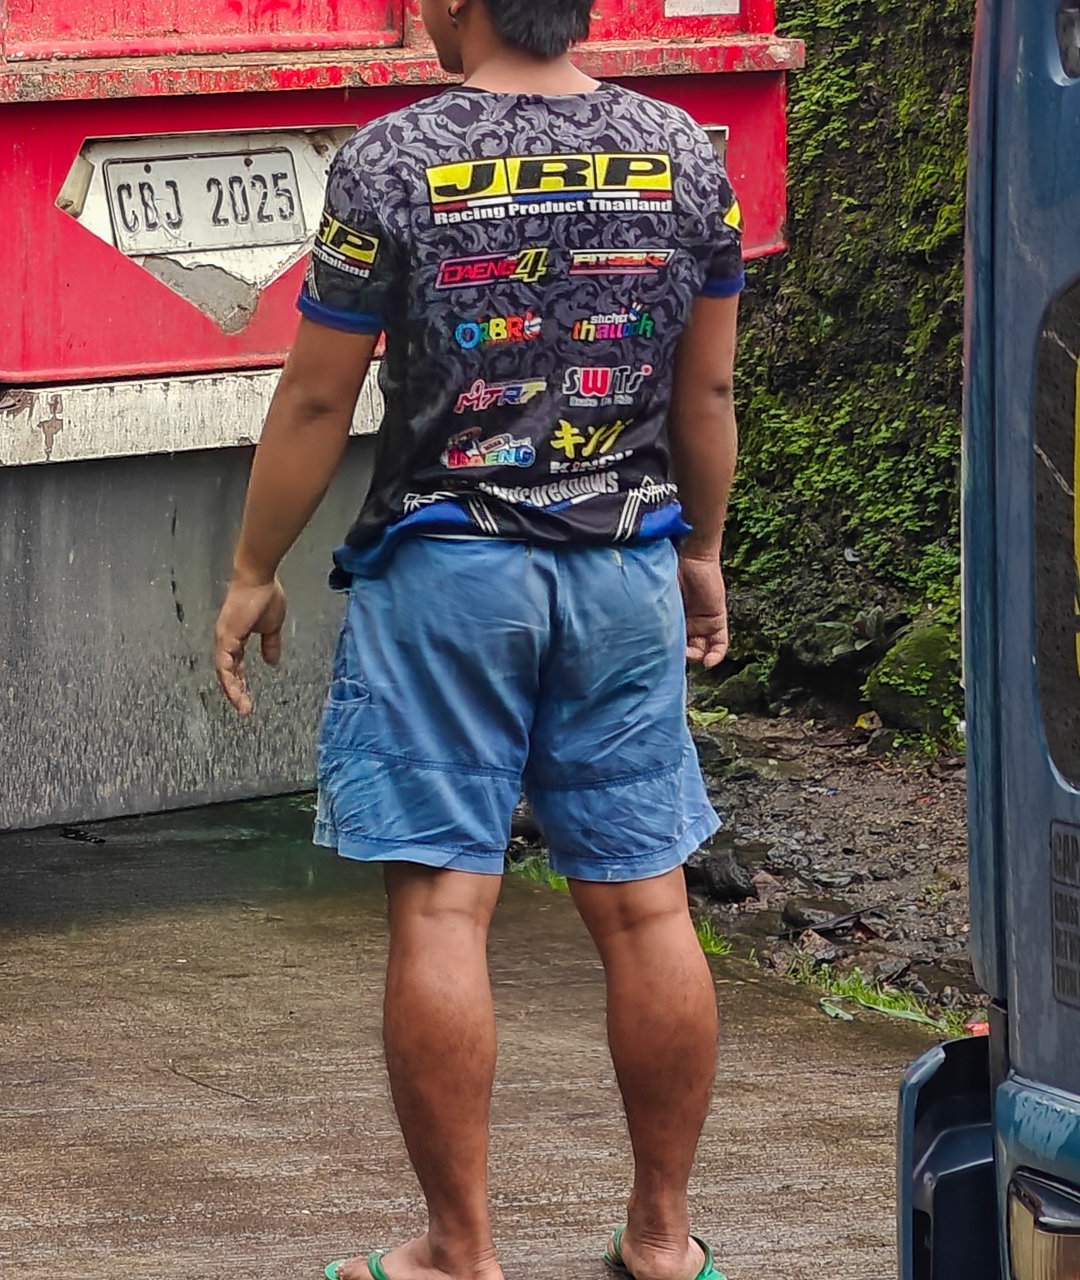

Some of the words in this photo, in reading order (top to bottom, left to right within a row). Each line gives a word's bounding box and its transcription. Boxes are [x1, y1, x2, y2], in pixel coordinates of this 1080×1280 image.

[433, 156, 668, 198] JRP
[117, 179, 184, 233] CBJ
[206, 172, 295, 226] 2025
[434, 205, 505, 226] Racing
[508, 200, 585, 217] Product
[588, 198, 673, 214] Thailand
